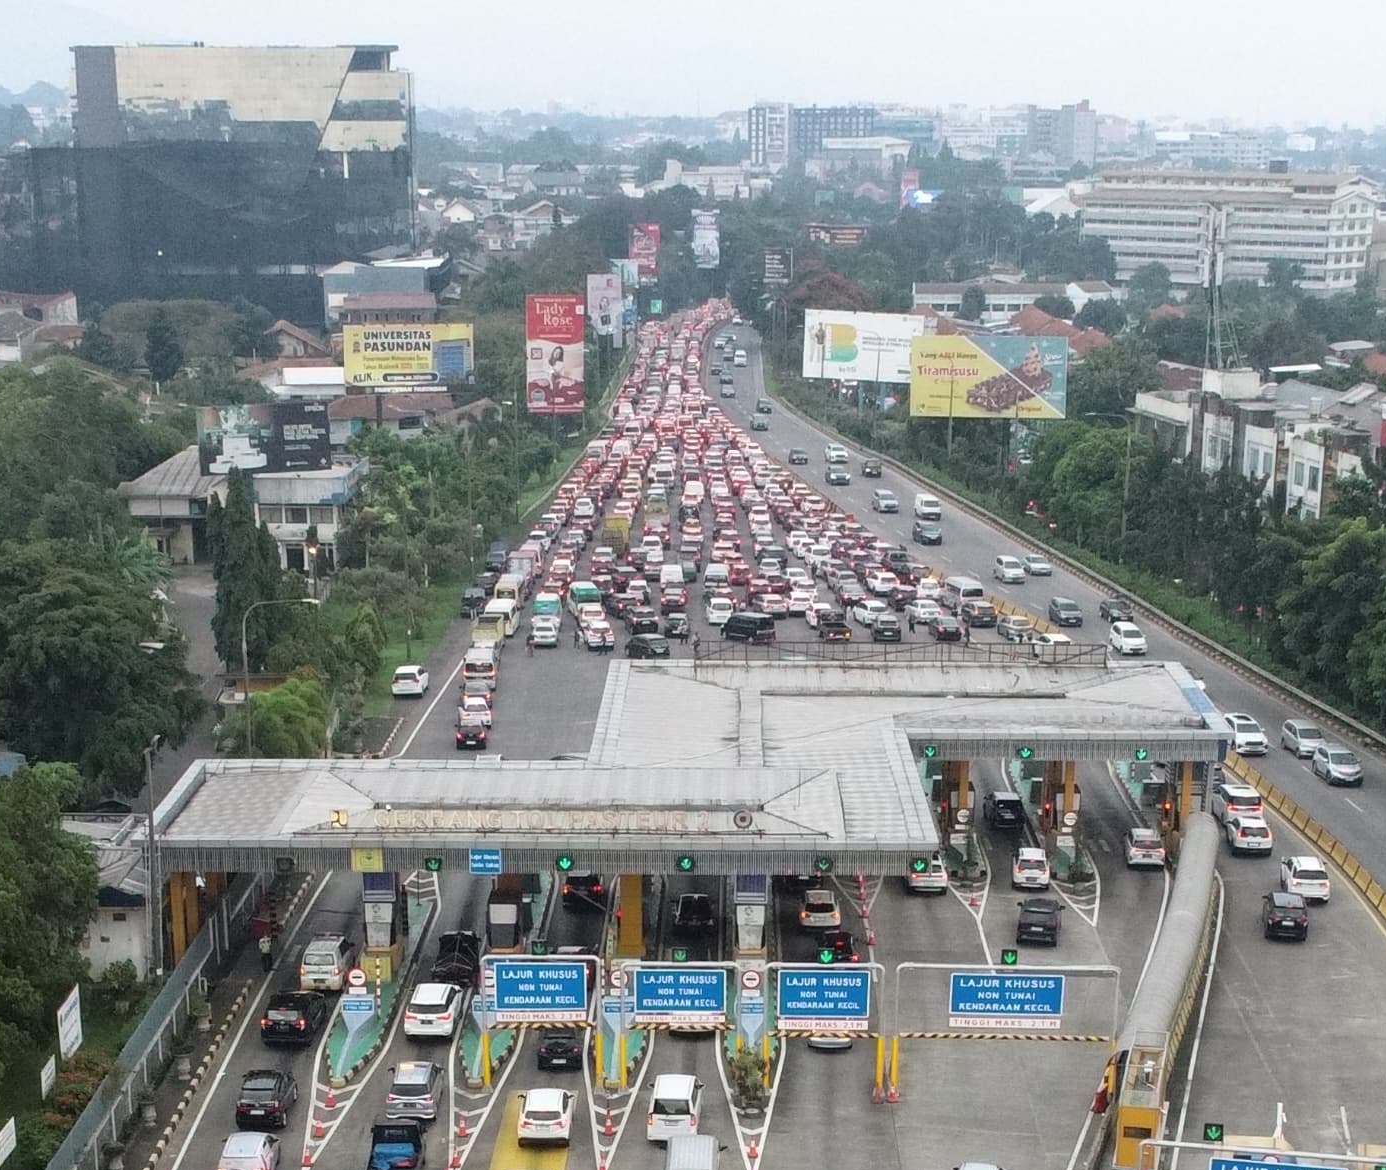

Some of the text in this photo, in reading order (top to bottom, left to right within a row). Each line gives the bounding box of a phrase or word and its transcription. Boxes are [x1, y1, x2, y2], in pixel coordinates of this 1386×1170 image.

[536, 302, 565, 317] Lady
[543, 313, 573, 327] Rose
[363, 331, 431, 340] UNIVERSITAS
[364, 341, 431, 352] PASUNDAN
[917, 364, 979, 377] Tiramisusu
[373, 810, 502, 829] GERBANG
[513, 811, 554, 829] TOL
[566, 811, 687, 831] PASTEUR
[502, 970, 578, 979] LAJUR KHUSUS
[643, 975, 718, 984] LAJUR KHUSUS
[786, 977, 862, 986] LAJUR KHUSUS
[960, 978, 1055, 989] LAJUR KHUSUS
[518, 983, 563, 991] NON TUNAI
[504, 995, 578, 1004] KENDARAAN KECIL
[978, 991, 1036, 1000] NON TUNAI
[643, 999, 718, 1007] KENDARAAN KECIL
[787, 1001, 860, 1009] KENDARAAN KECIL
[959, 1002, 1053, 1012] KENDARAAN KECIL
